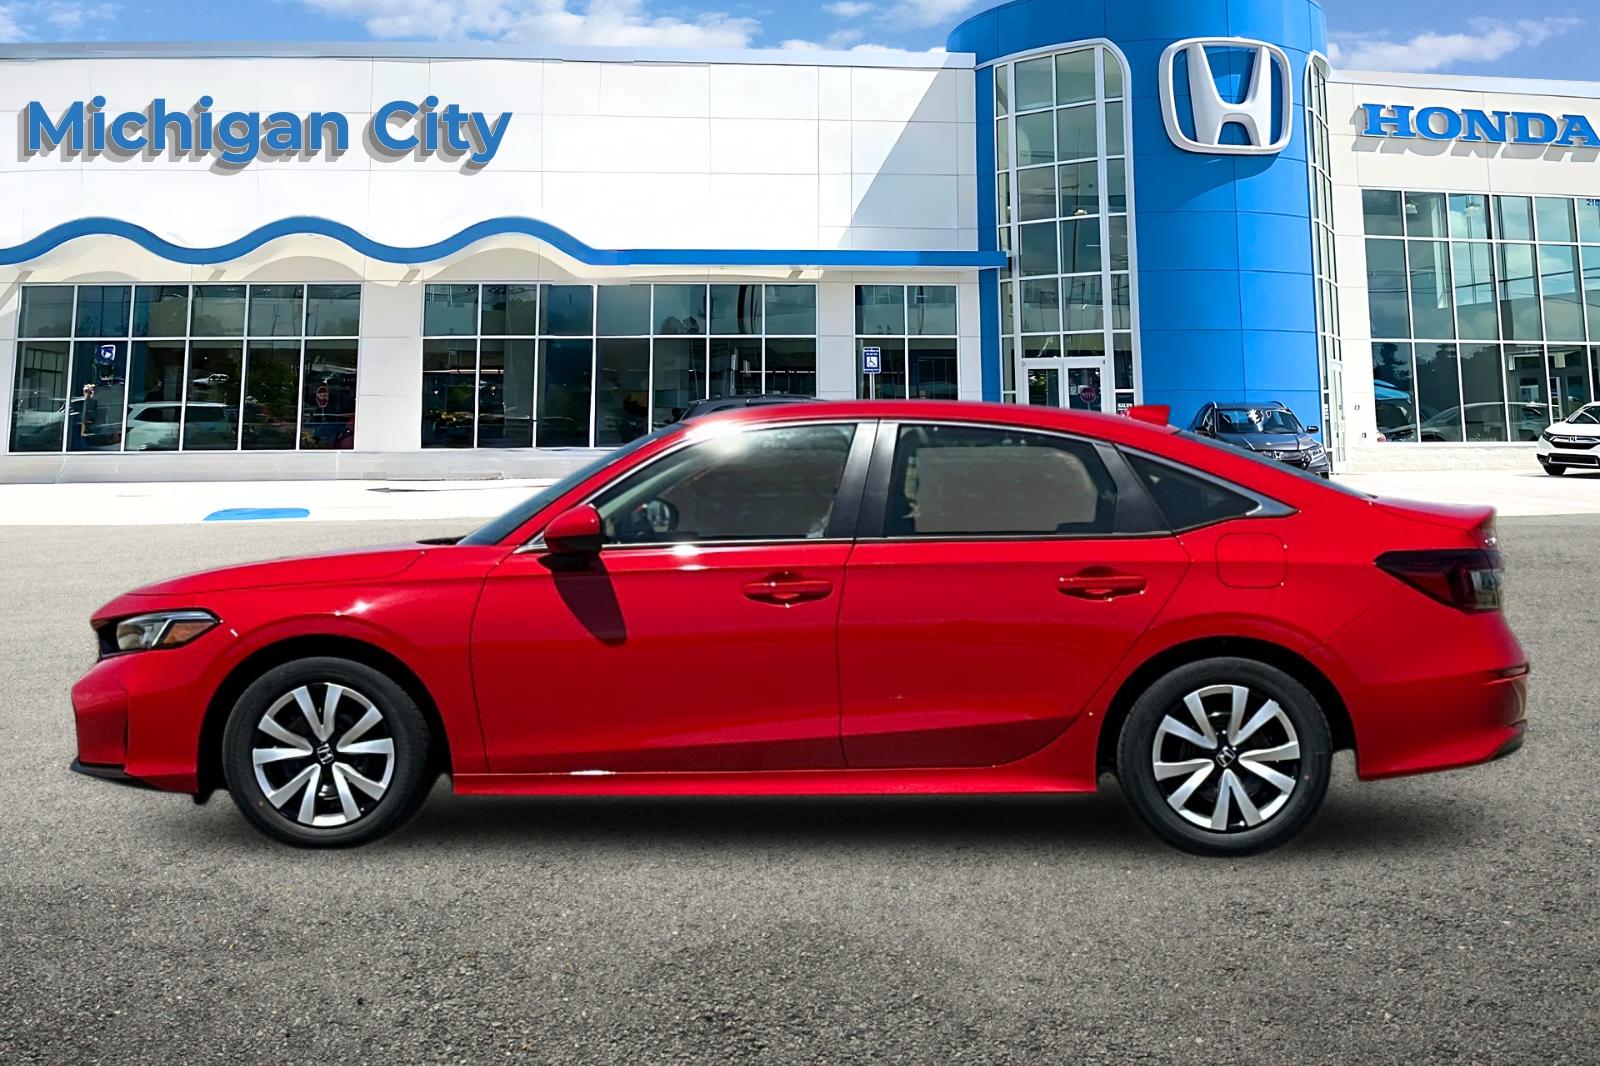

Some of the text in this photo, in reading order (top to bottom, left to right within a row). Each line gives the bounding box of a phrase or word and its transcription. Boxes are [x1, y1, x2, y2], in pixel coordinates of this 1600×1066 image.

[28, 95, 513, 164] Michigan City
[1360, 103, 1600, 147] HONDA
